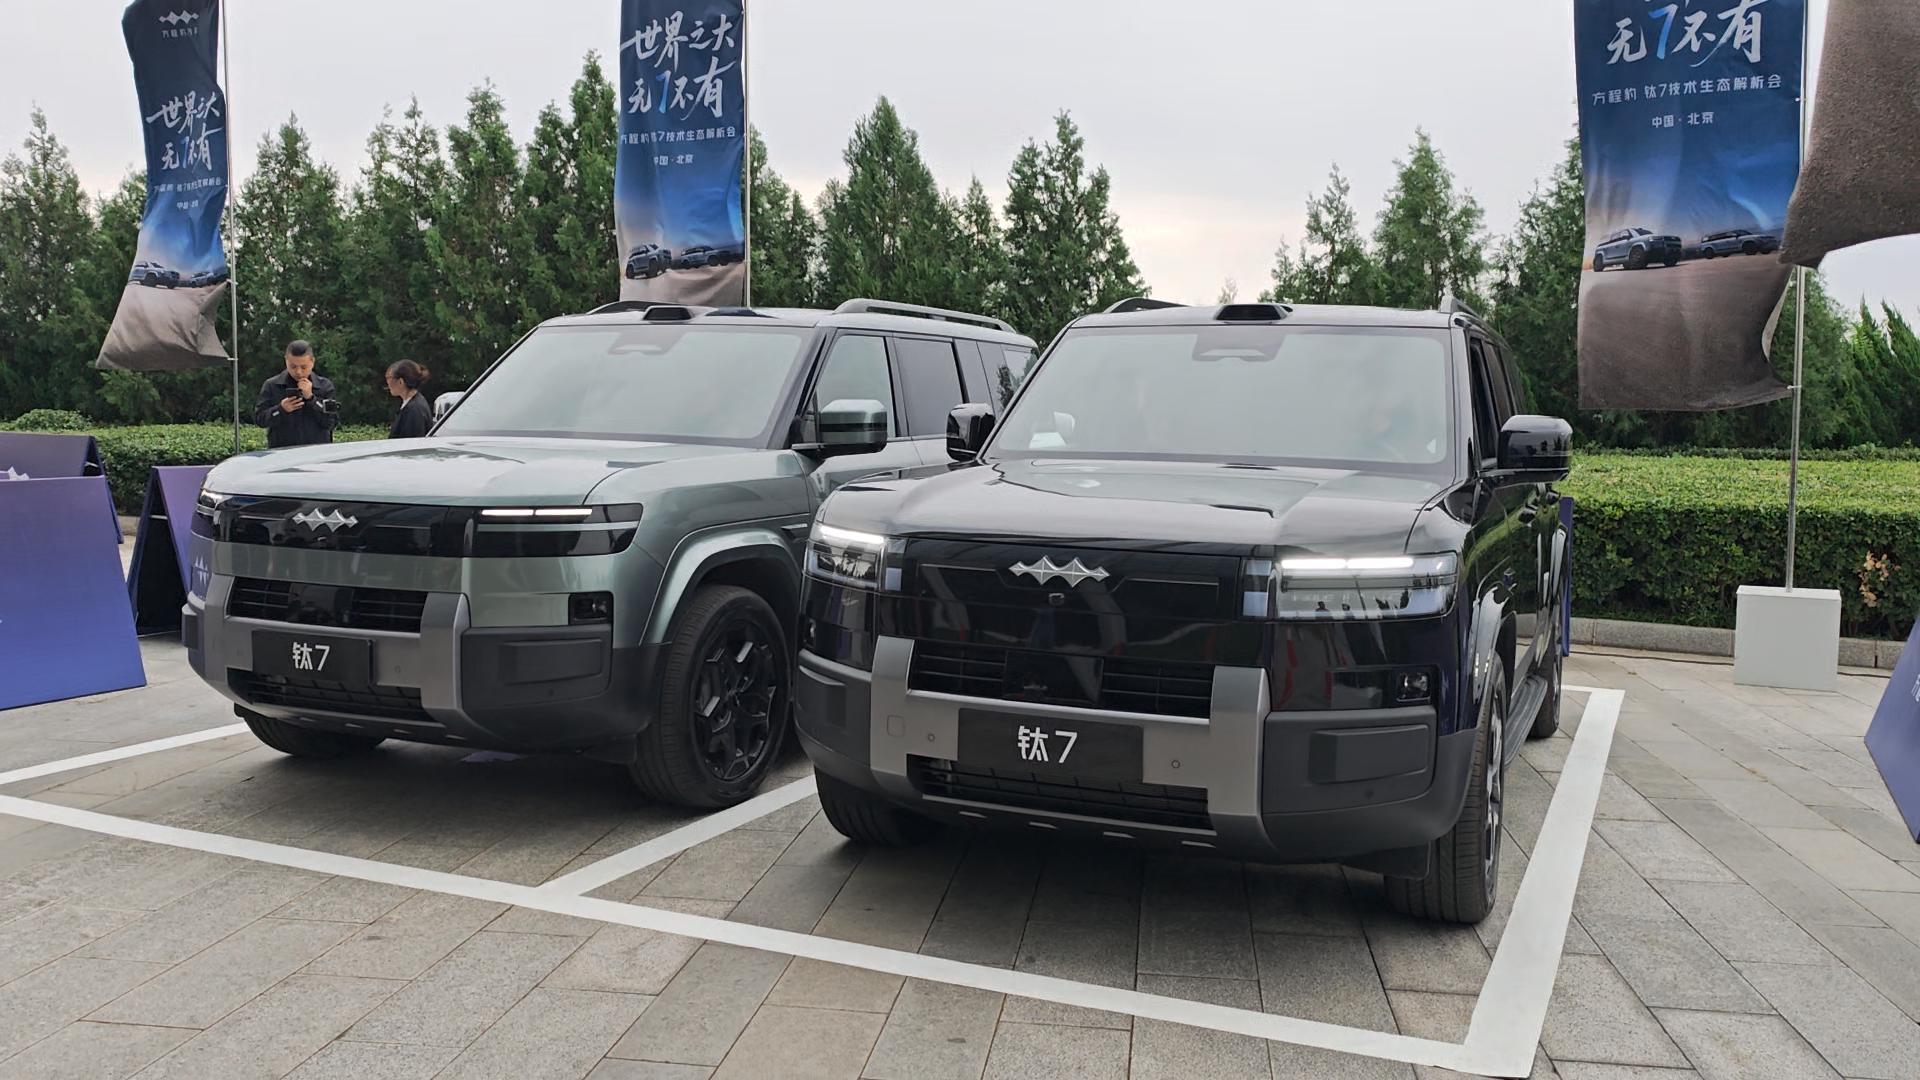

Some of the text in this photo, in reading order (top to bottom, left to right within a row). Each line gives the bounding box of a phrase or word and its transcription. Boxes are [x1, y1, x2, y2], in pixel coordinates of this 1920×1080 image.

[620, 10, 735, 72] 世界之大
[1606, 0, 1772, 67] 无7不有
[628, 56, 736, 121] 无7不有
[1592, 74, 1782, 106] 方程豹 钛7技术生态解析会
[292, 641, 330, 671] 钛7
[1017, 725, 1078, 764] 钛7
